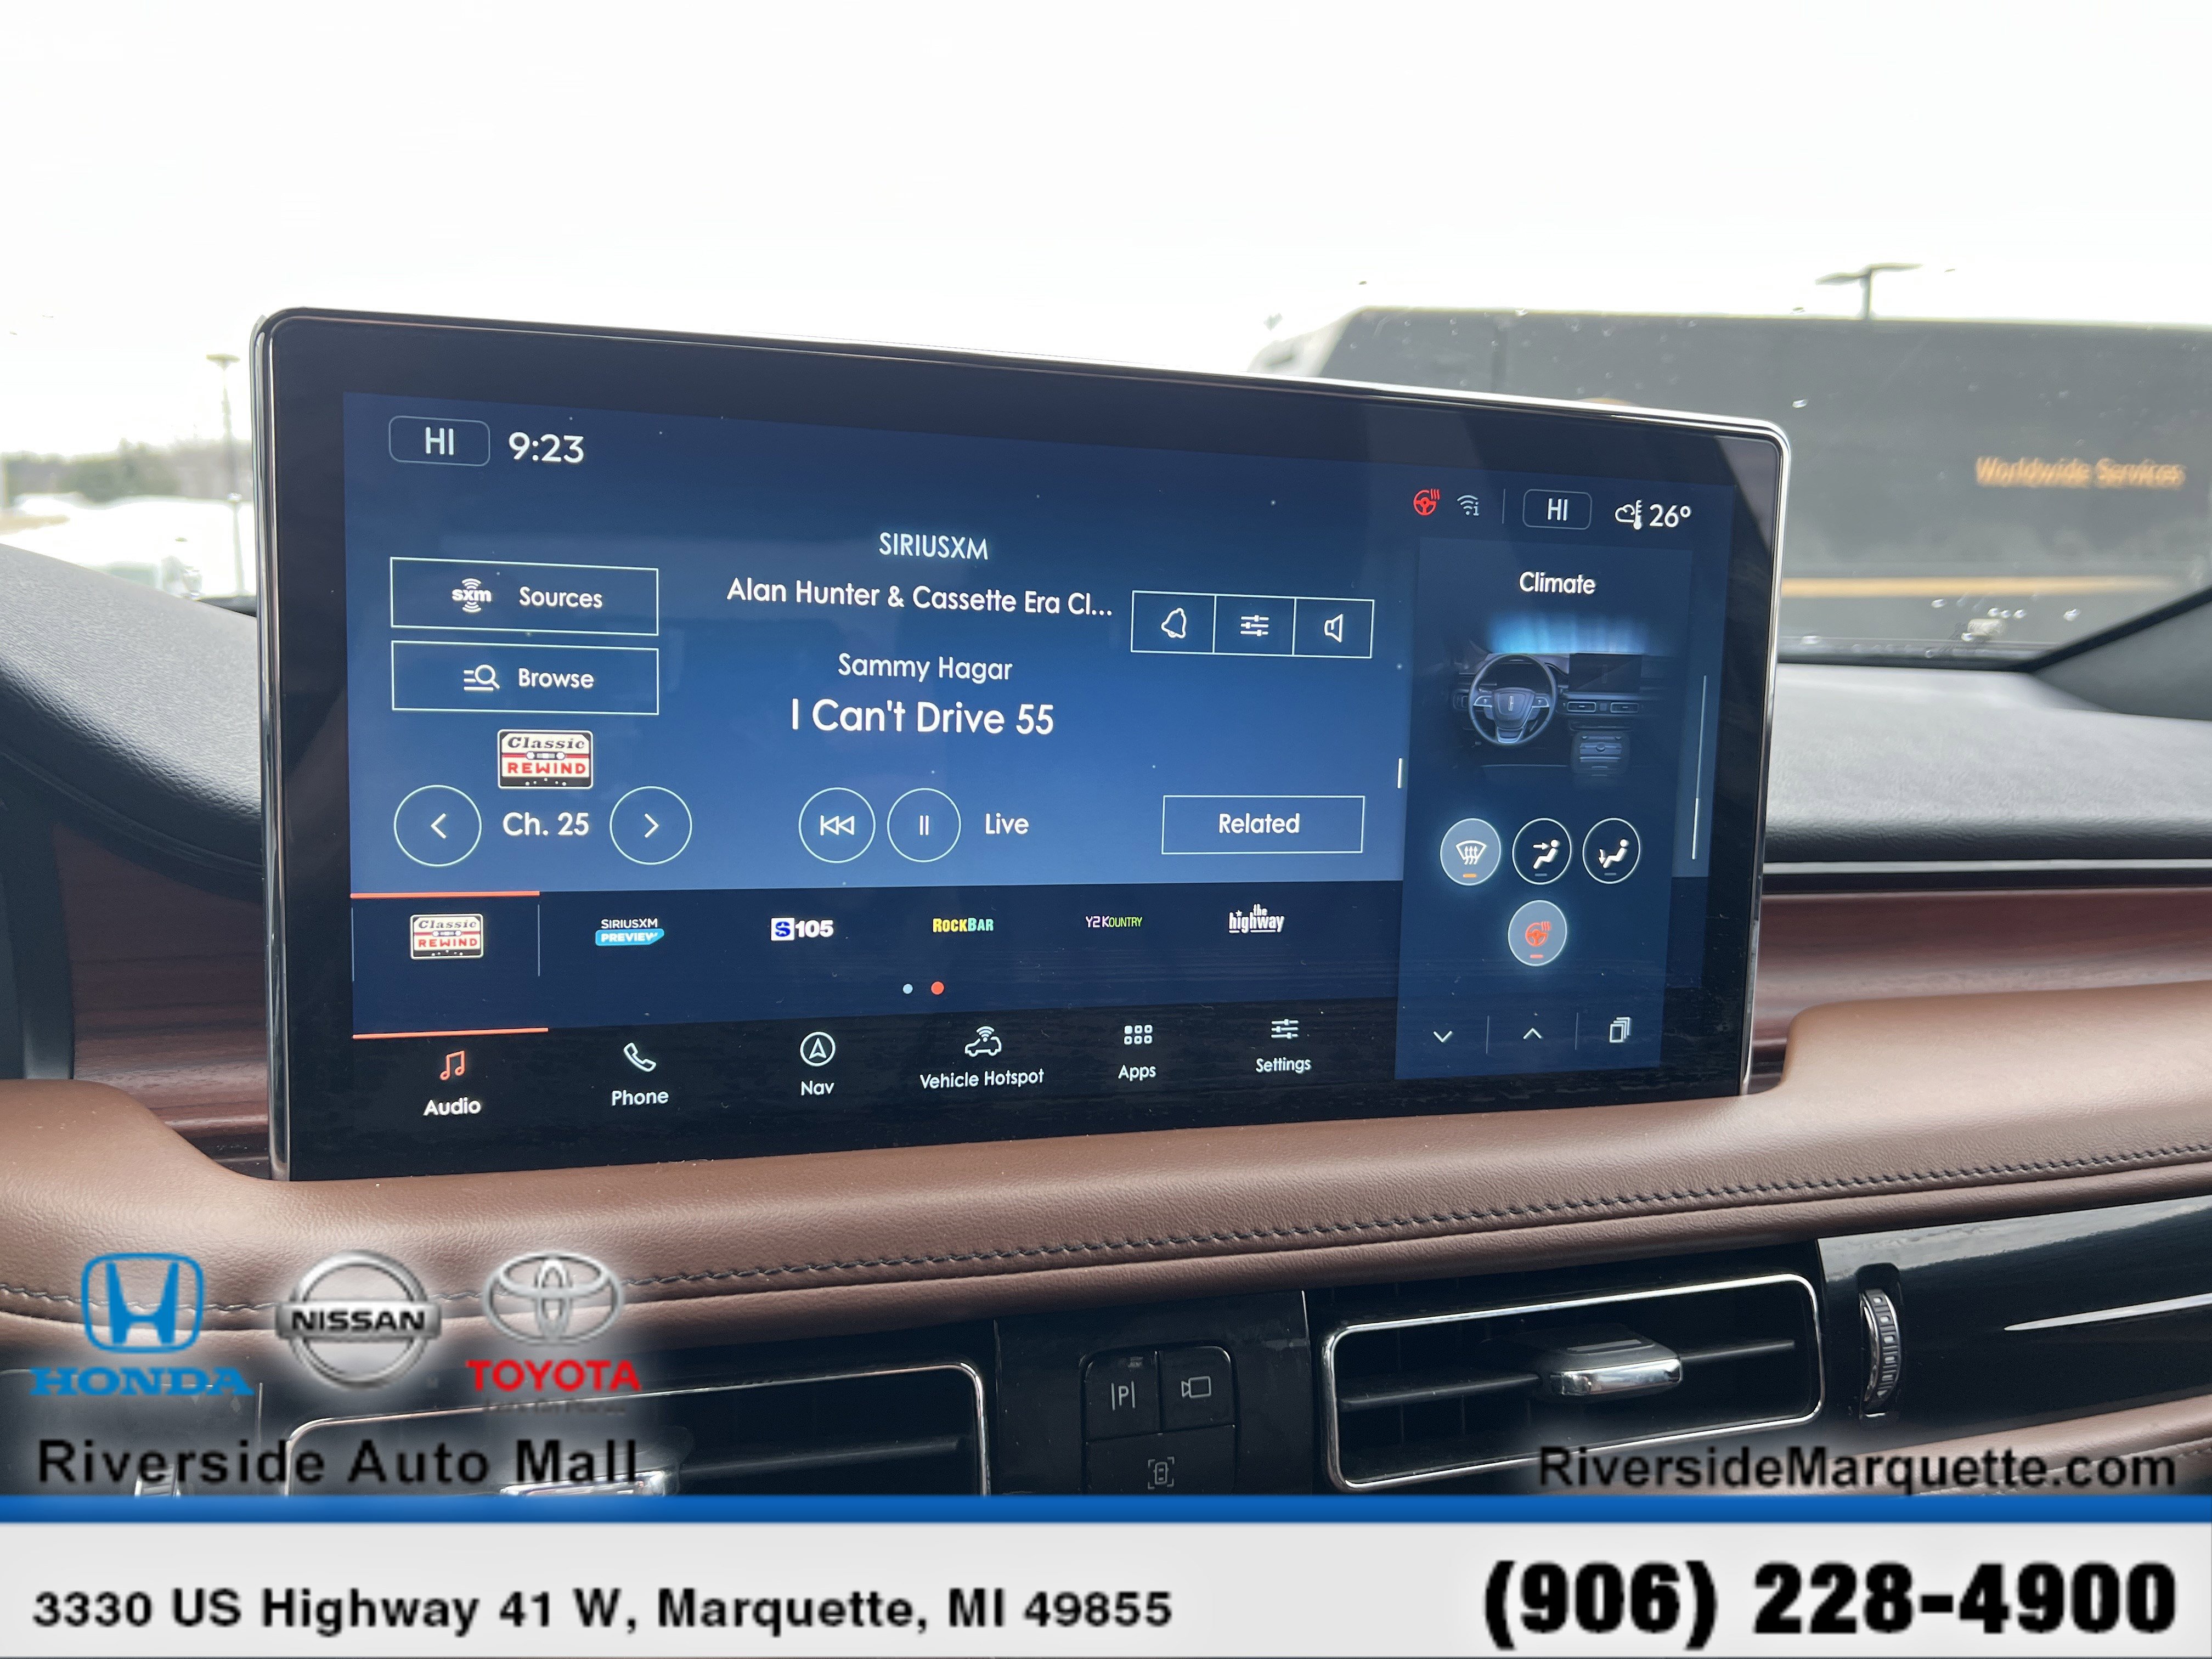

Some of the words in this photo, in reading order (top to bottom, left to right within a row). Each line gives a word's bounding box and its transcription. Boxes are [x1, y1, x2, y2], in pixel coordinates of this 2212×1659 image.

[425, 426, 455, 455] HI
[508, 432, 585, 464] 9:23
[1976, 456, 2092, 487] Worldwide
[2095, 457, 2186, 489] Services
[1547, 498, 1568, 521] HI
[878, 532, 989, 560] SIRIUSXM
[1519, 571, 1596, 594] Climate
[452, 587, 492, 603] sxm
[519, 586, 603, 608] Sources
[726, 578, 787, 602] Alan
[795, 580, 880, 606] Hunter
[887, 586, 905, 607] &
[912, 585, 1017, 612] Cassette
[1025, 591, 1060, 614] Era
[518, 668, 594, 689] Browse
[838, 653, 930, 682] Sammy
[939, 657, 1013, 684] Hagar
[792, 698, 799, 730] I
[812, 698, 905, 732] Can't
[918, 702, 1005, 734] Drive
[1016, 704, 1054, 735] 55
[507, 736, 585, 750] Classic
[507, 763, 586, 775] REWIND
[503, 812, 549, 836] Ch.
[557, 812, 590, 836] 25
[985, 814, 1030, 835] Live
[1218, 812, 1300, 833] Related
[1253, 904, 1268, 916] the
[417, 919, 477, 929] Classic
[601, 918, 658, 929] SIRIUSXM
[1229, 910, 1285, 933] highway
[418, 938, 477, 948] REWIND
[601, 932, 658, 942] PREVIEW
[1118, 1064, 1156, 1081] Apps
[1256, 1057, 1312, 1075] Settings
[801, 1081, 834, 1096] Nav
[920, 1071, 979, 1089] Vehicle
[984, 1069, 1045, 1087] Hotspot
[424, 1098, 481, 1116] Audio
[611, 1089, 669, 1107] Phone
